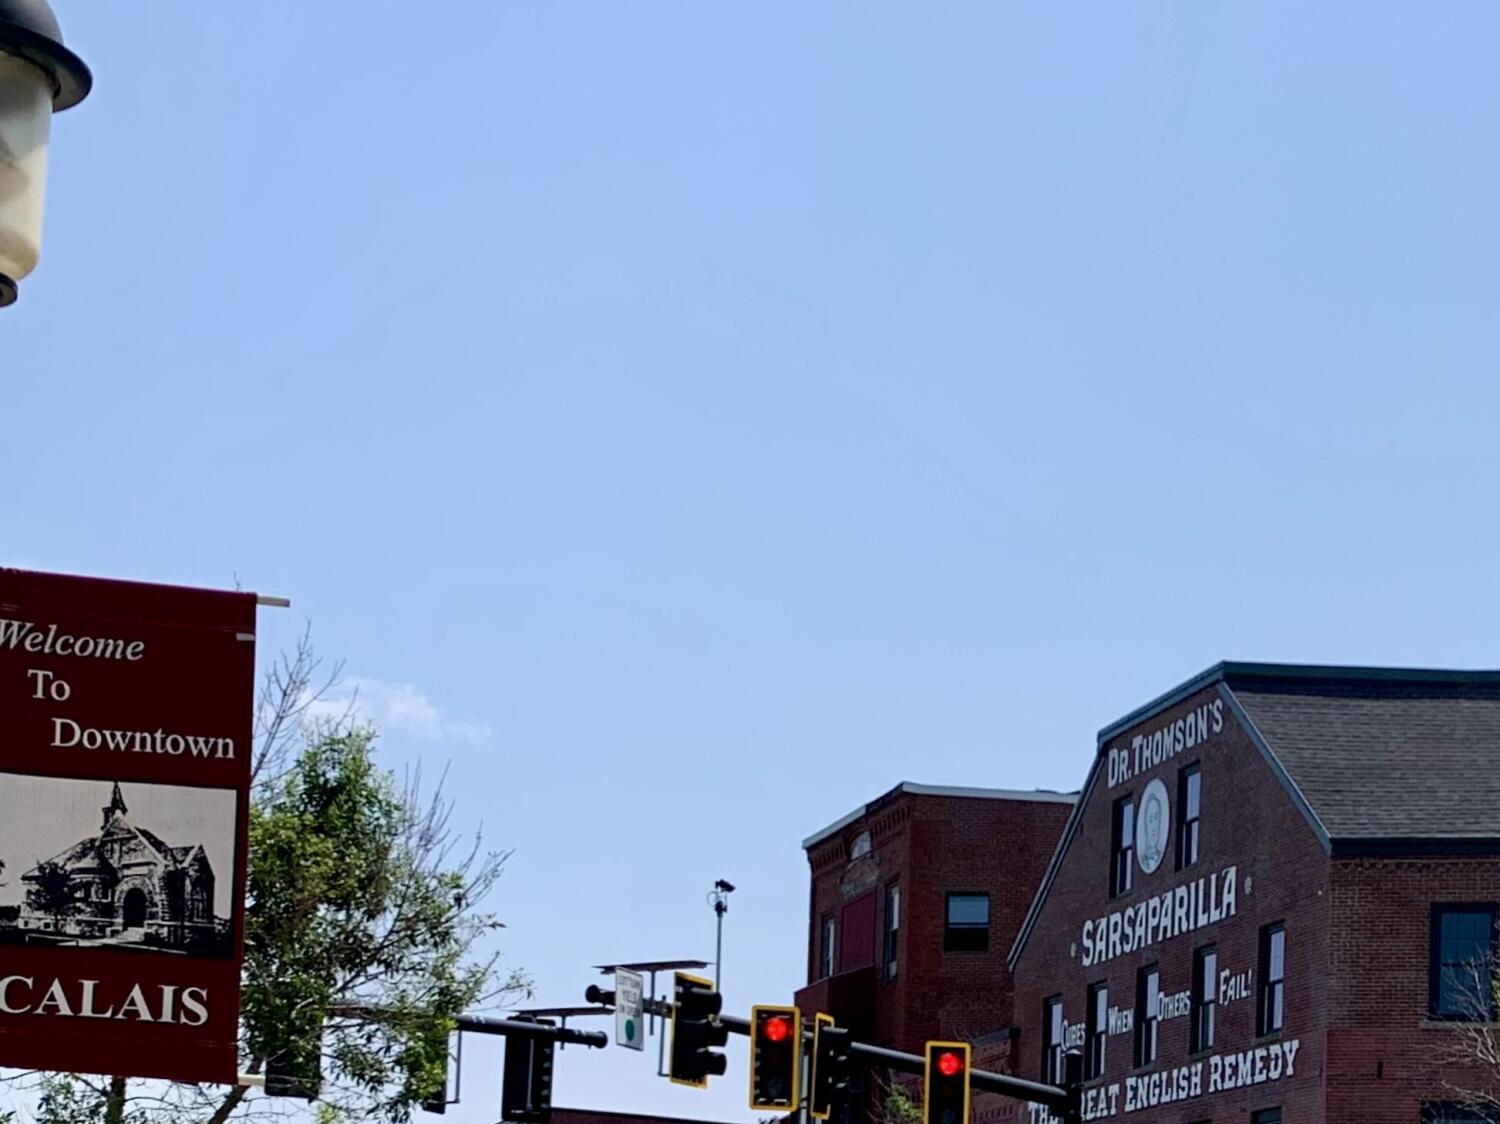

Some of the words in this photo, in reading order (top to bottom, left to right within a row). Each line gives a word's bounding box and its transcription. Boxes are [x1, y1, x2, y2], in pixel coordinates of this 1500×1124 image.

[0, 618, 145, 661] Welcome
[27, 669, 71, 701] To
[50, 717, 236, 760] Downtown
[1081, 865, 1238, 967] SARSAPARILLA
[0, 974, 210, 1027] CALAIS
[1124, 1061, 1203, 1113] ENGLISH
[1208, 1039, 1300, 1094] REMEDY
